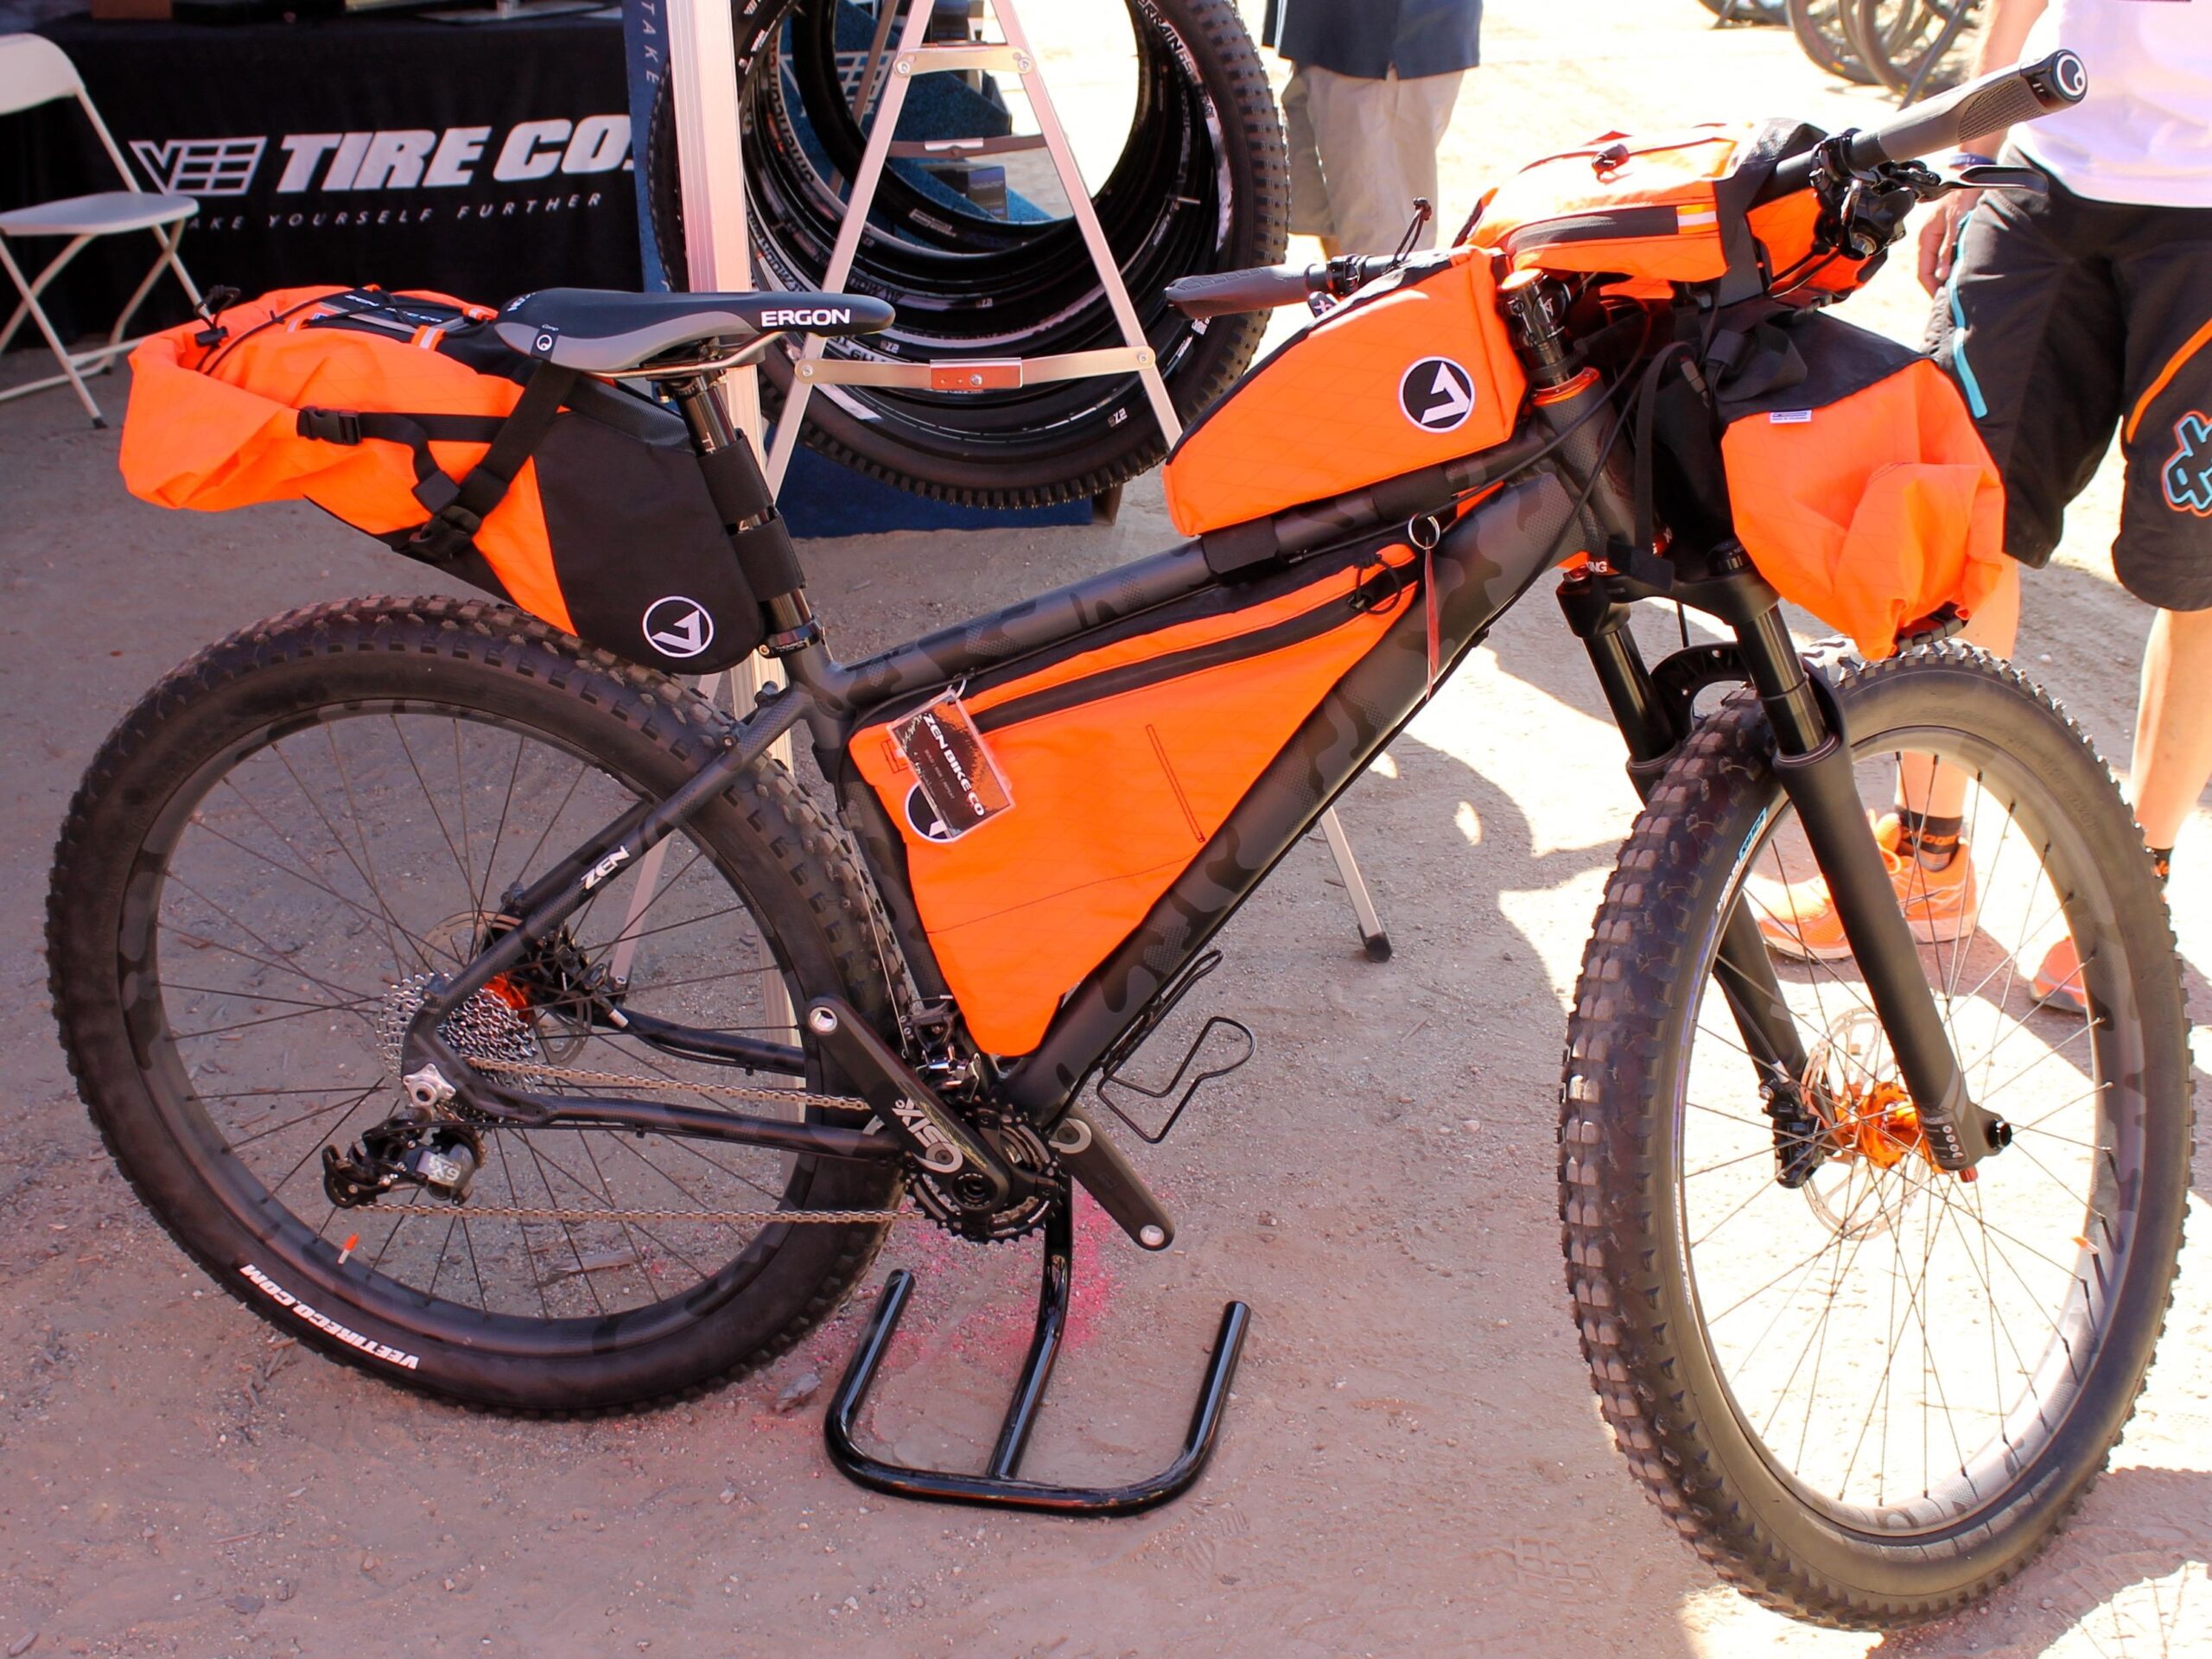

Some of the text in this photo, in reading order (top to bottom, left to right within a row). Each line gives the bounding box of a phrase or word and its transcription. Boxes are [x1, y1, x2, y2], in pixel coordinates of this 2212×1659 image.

[640, 0, 660, 84] TAKE
[276, 125, 492, 193] TIRE
[188, 193, 601, 231] AKE YOURSELF FURTHER
[760, 308, 851, 327] ERGON
[923, 713, 985, 817] ZEN BIKE CO
[580, 845, 631, 890] ZEN
[239, 1263, 420, 1370] VEETIRECO.COM
